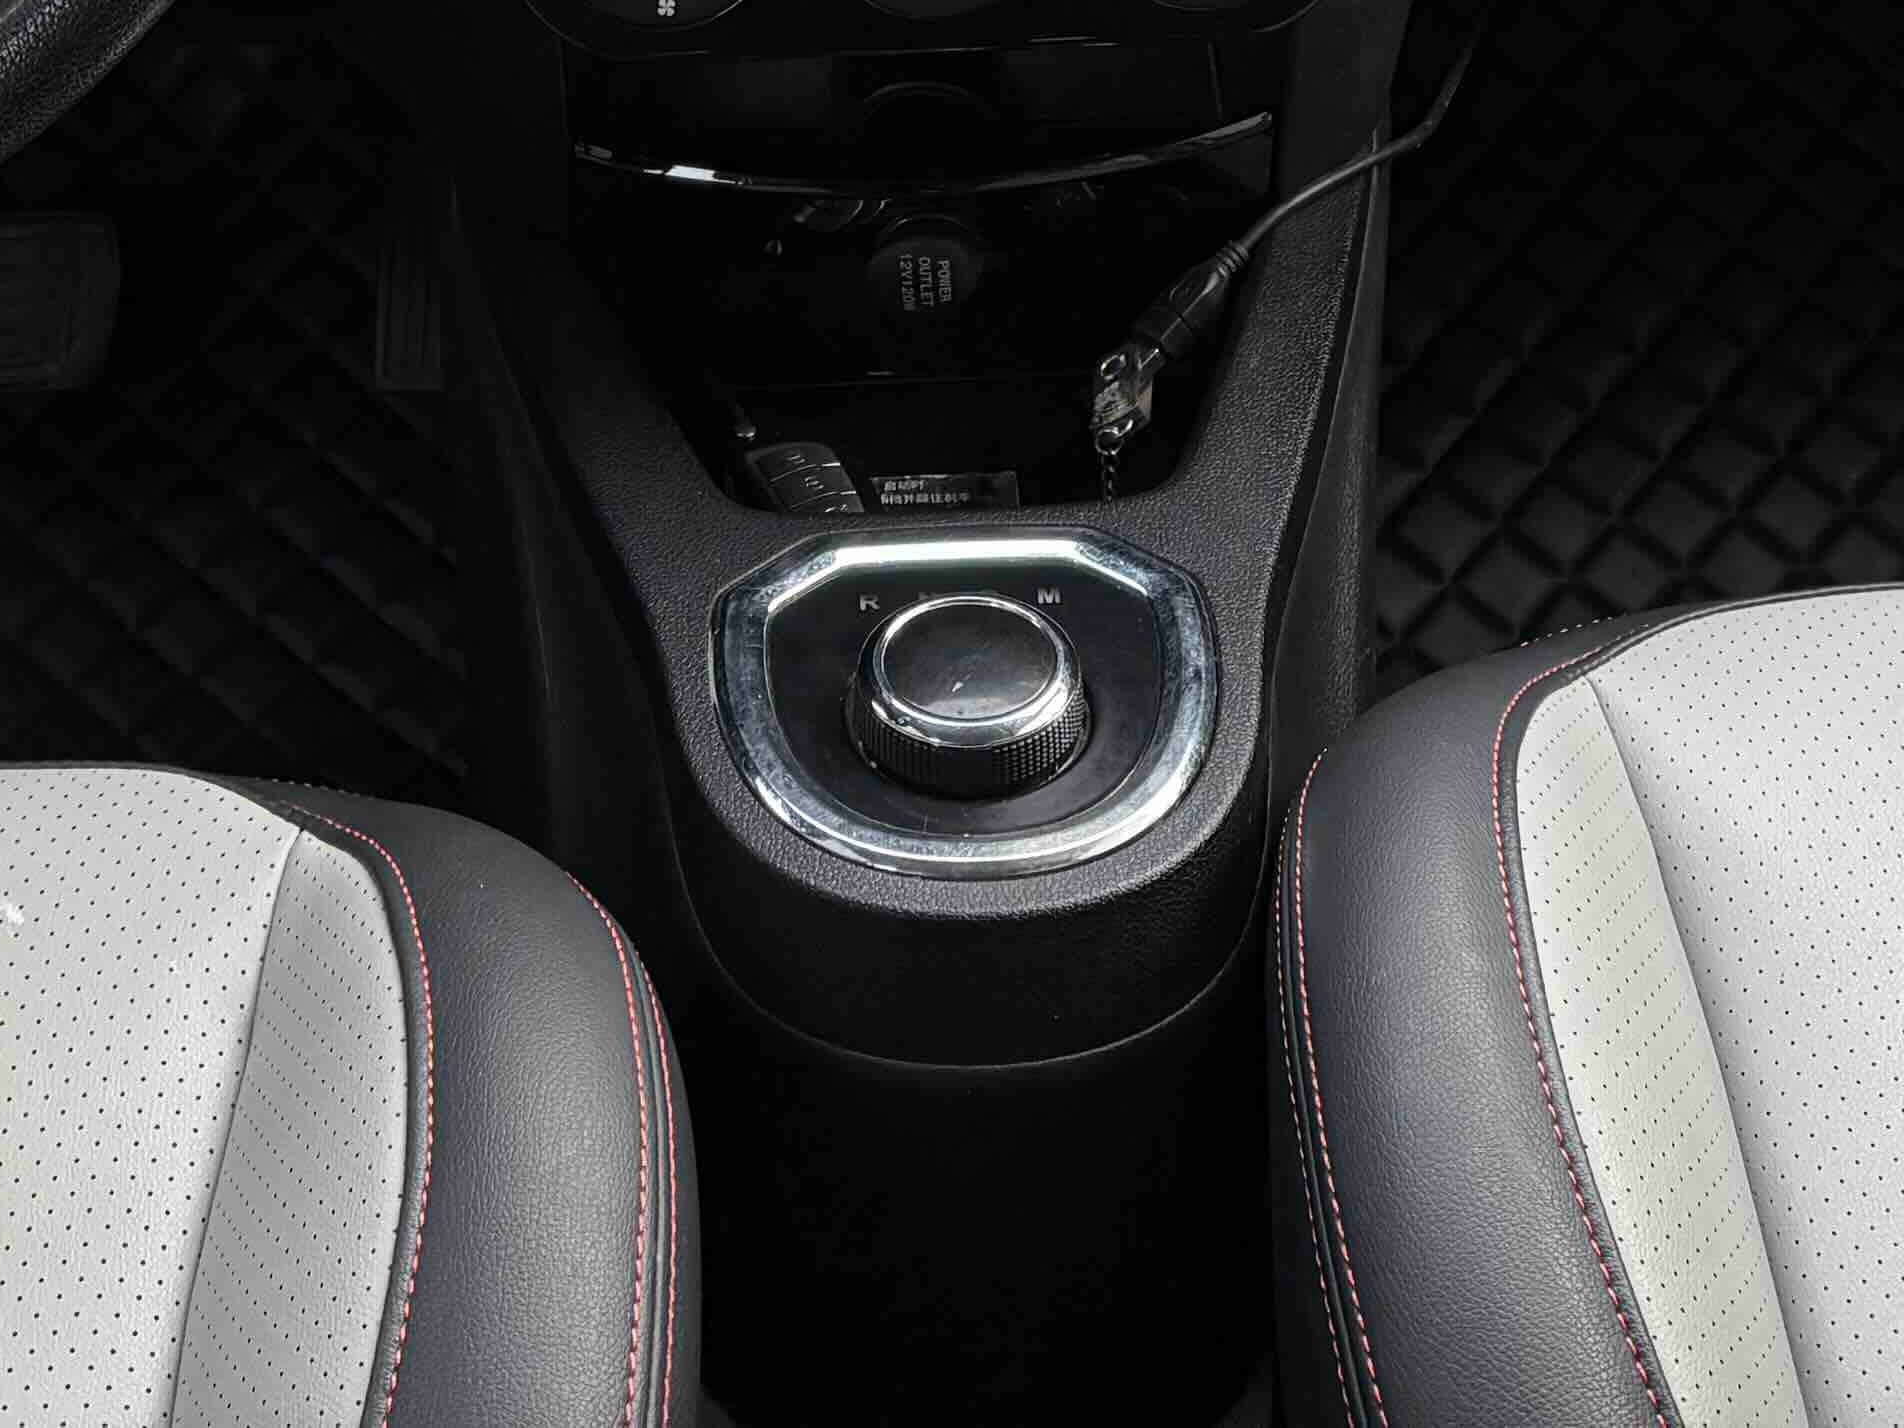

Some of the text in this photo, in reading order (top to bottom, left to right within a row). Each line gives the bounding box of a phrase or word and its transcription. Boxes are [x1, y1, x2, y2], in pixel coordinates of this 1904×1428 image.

[918, 256, 934, 307] OUTLET
[937, 259, 953, 303] POWER
[857, 593, 881, 612] R
[1036, 586, 1063, 605] M
